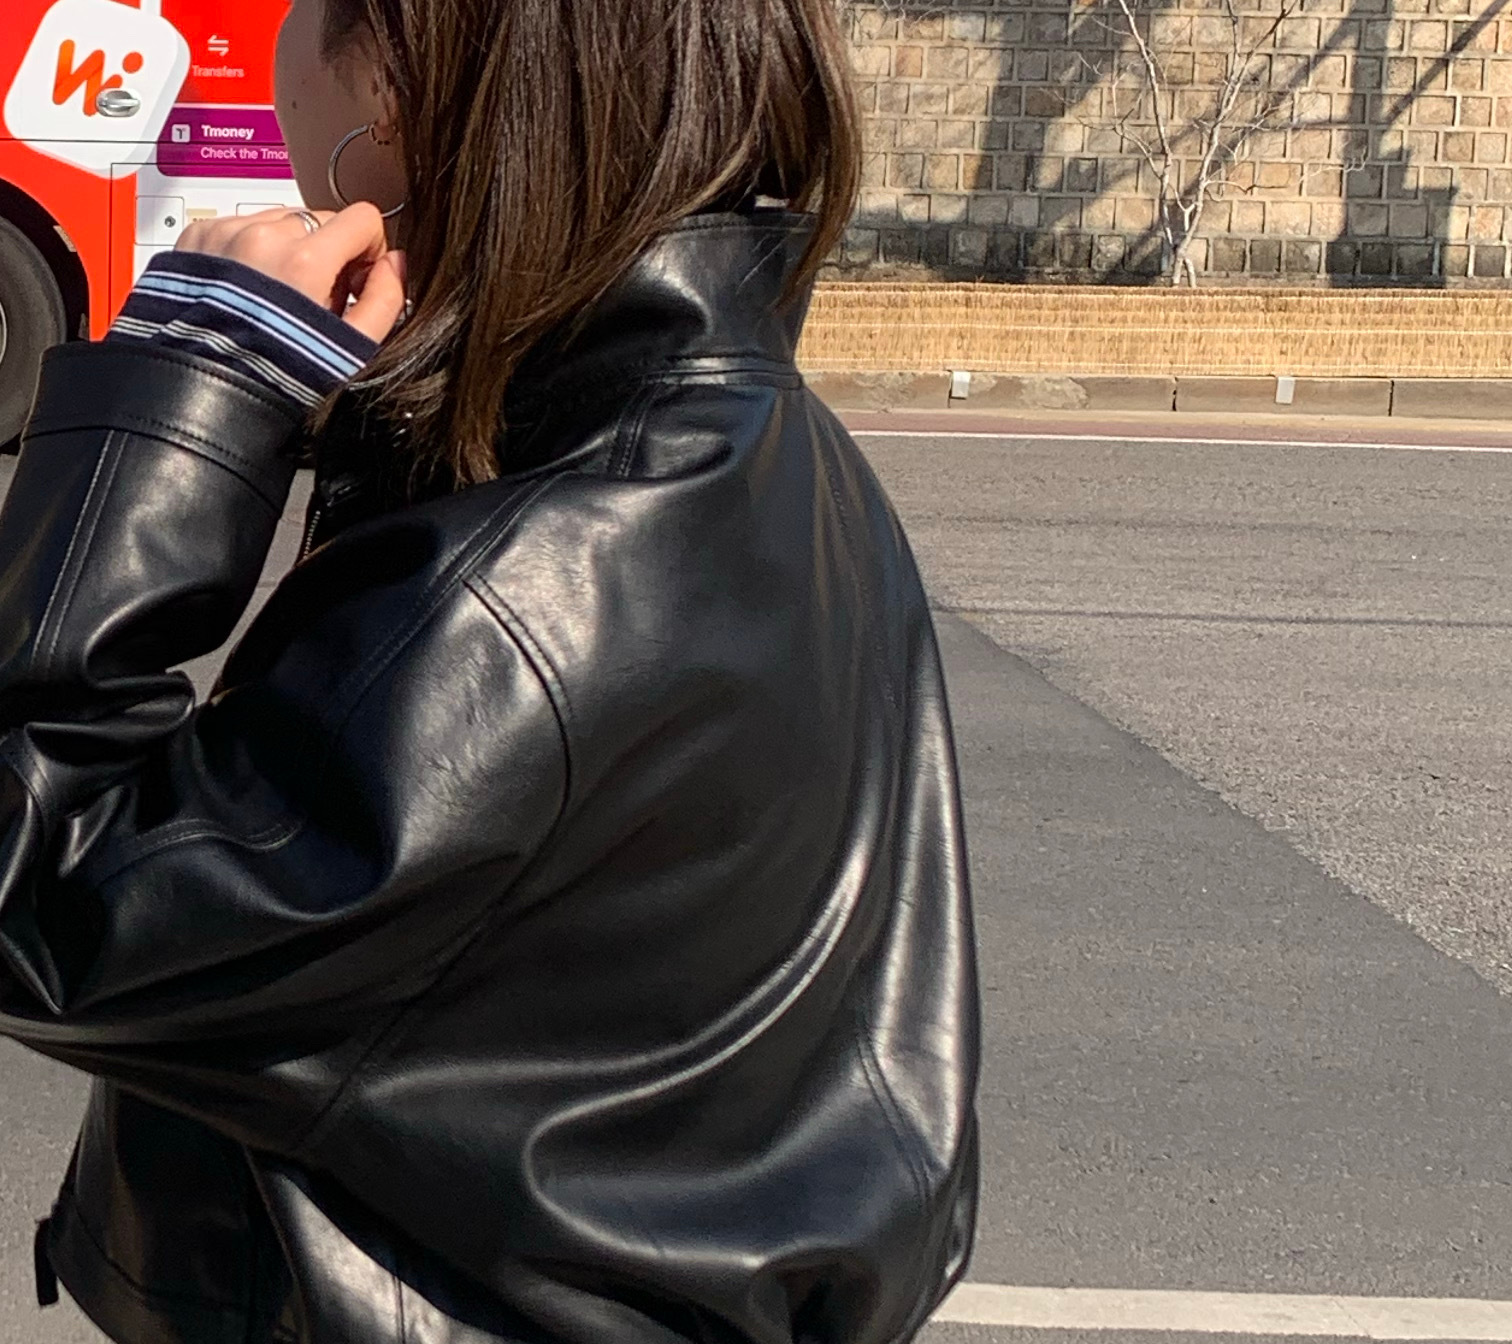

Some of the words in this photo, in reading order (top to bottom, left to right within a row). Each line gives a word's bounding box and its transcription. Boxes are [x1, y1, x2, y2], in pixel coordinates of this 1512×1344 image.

[191, 65, 245, 78] Transfers
[201, 124, 255, 140] Tmoney
[200, 146, 237, 160] Check
[239, 148, 259, 160] the
